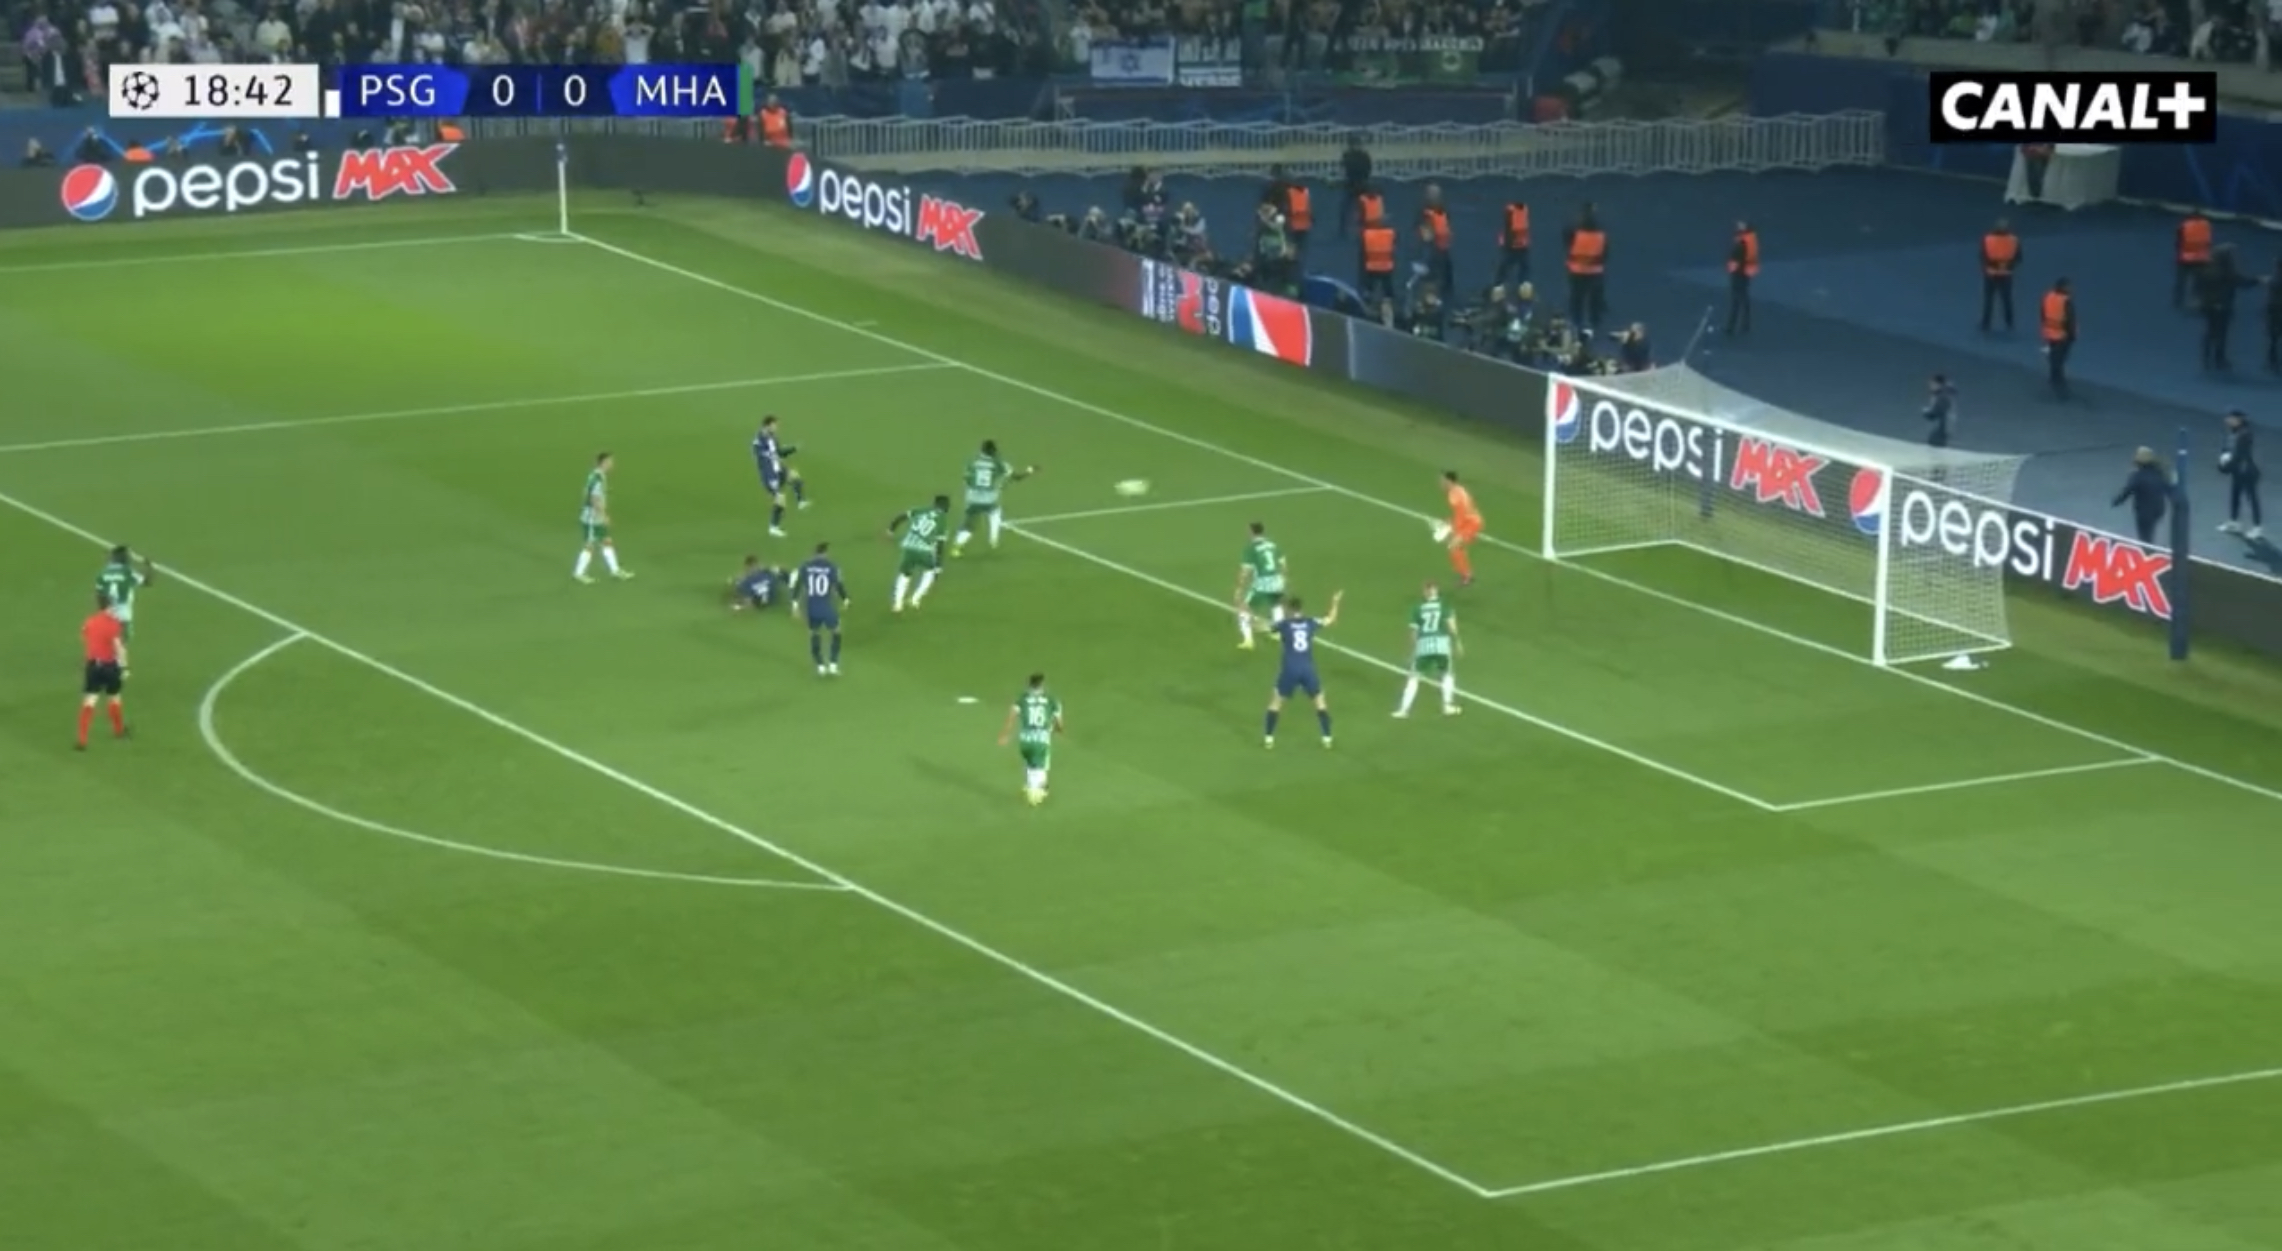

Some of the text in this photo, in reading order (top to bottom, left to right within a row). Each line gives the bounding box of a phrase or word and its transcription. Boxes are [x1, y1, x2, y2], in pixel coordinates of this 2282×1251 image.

[133, 143, 460, 217] pepsi MAX
[819, 169, 985, 261] pepsi MAX
[1590, 400, 1830, 518] pepsi MAX
[807, 573, 830, 597] 10
[1901, 490, 2173, 620] pepsi MAX
[1293, 629, 1308, 652] 8
[1027, 705, 1046, 727] 16
